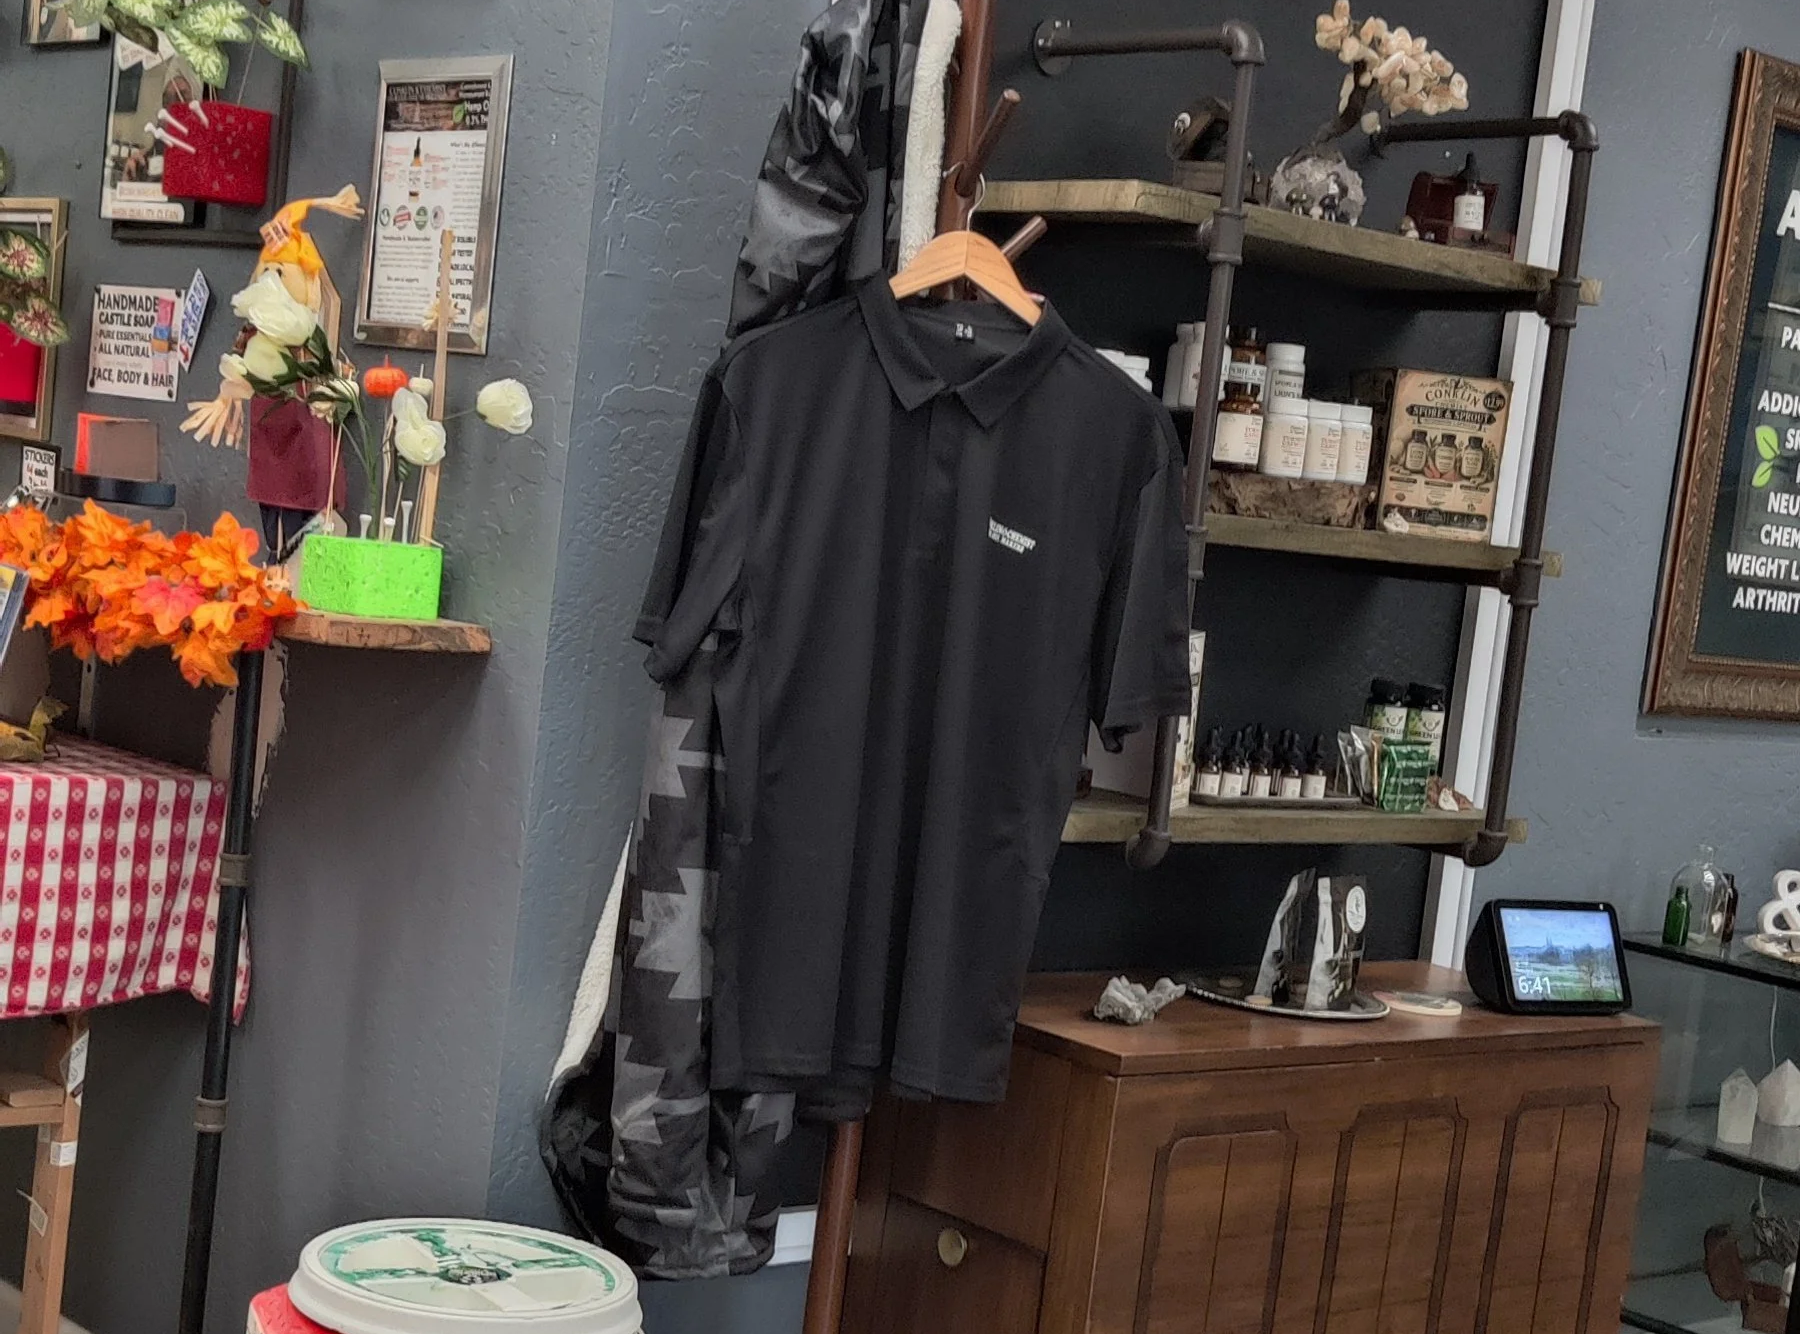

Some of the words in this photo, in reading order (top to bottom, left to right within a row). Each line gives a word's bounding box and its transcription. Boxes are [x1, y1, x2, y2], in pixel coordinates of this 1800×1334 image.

[98, 293, 159, 313] HANDMADE
[99, 312, 132, 326] CASTILE
[133, 315, 155, 328] SOAP
[116, 330, 152, 343] ESSENTIALS
[98, 343, 112, 355] ALL
[114, 345, 150, 359] NATURAL
[117, 370, 141, 384] BODY
[143, 372, 149, 386] &
[151, 373, 175, 387] HAIR
[1425, 388, 1480, 408] CONKLIN
[1726, 551, 1789, 581] WEIGHT
[1519, 976, 1551, 994] 6:41
